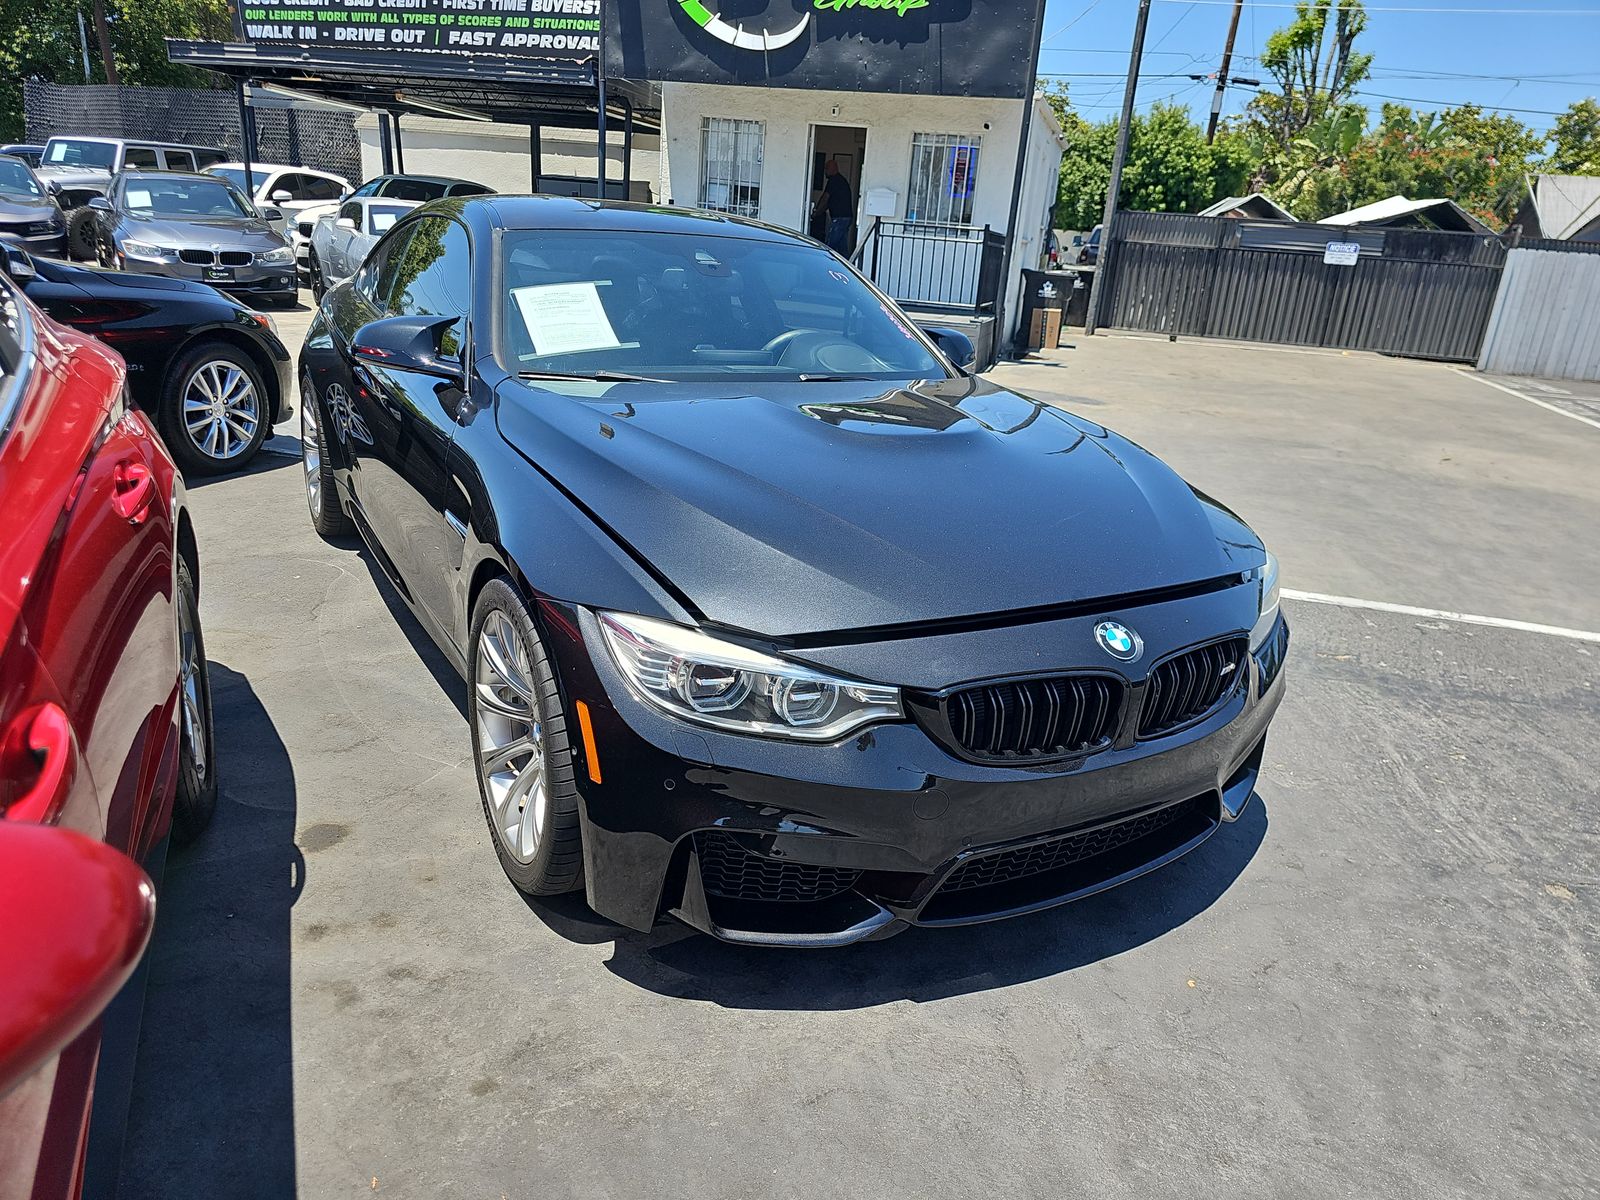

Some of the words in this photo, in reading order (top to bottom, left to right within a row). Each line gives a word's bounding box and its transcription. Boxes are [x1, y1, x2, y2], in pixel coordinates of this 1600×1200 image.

[442, 0, 486, 10] FIRST
[489, 0, 527, 11] TIME
[530, 0, 600, 14] BUYERS?
[245, 9, 267, 20] OUR
[268, 10, 315, 22] LENDERS
[317, 11, 349, 22] WORK
[350, 12, 378, 23] WITH
[380, 13, 400, 24] ALL
[402, 14, 437, 25] TYPES
[439, 15, 455, 25] OF
[457, 15, 502, 27] SCORES
[504, 17, 530, 28] AND
[532, 18, 600, 31] SITUATIONS
[245, 25, 294, 40] WALK
[298, 27, 317, 40] IN
[334, 27, 386, 42] DRIVE
[390, 29, 426, 43] OUT
[448, 31, 497, 46] FAST
[500, 33, 600, 50] APPROVAL
[1329, 244, 1357, 253] NOTICE
